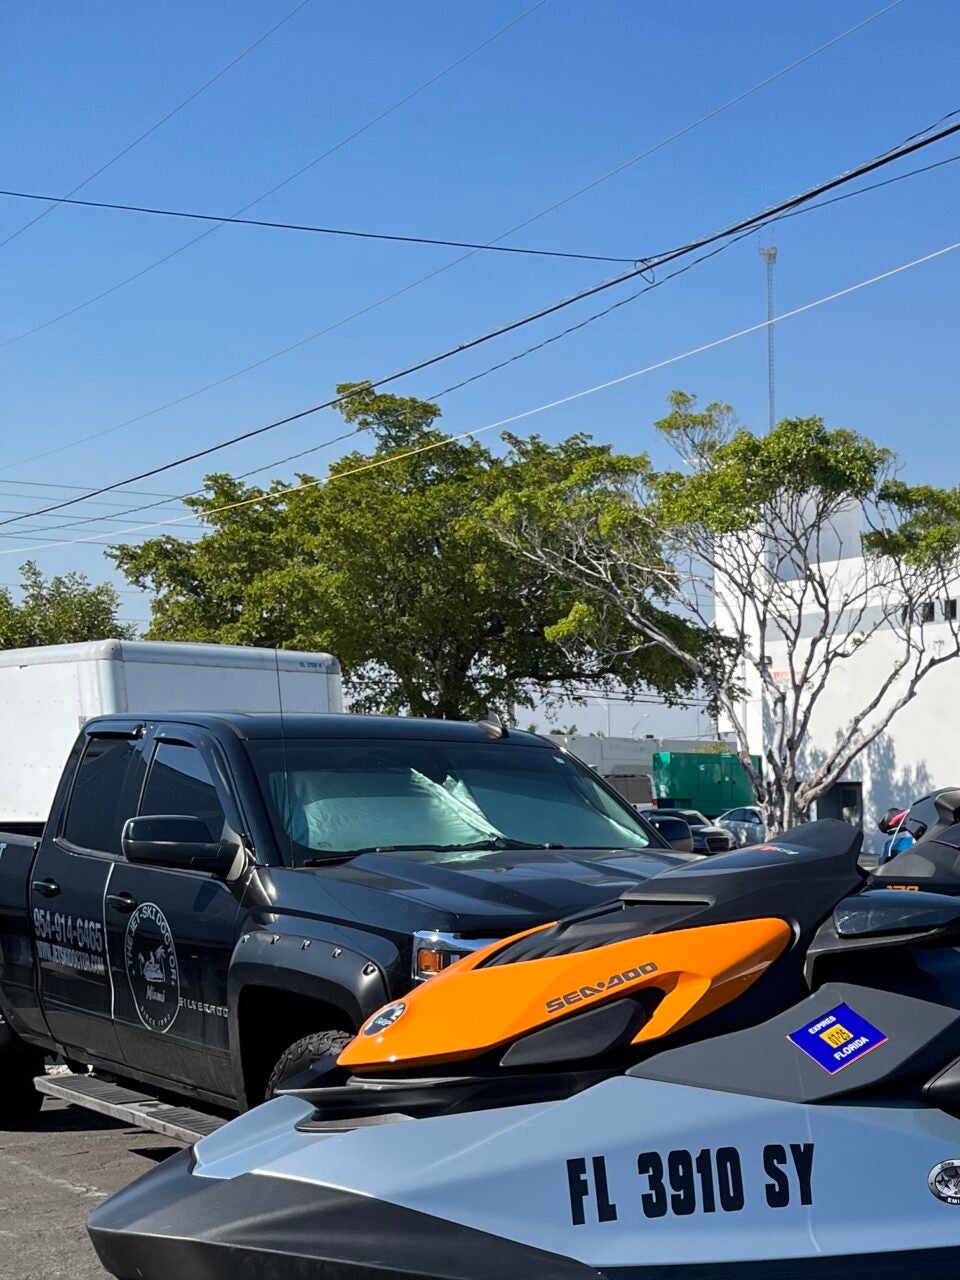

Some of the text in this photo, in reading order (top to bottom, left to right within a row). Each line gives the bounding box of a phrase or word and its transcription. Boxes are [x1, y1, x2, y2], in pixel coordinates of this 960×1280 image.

[33, 908, 102, 952] 954-914-6465
[155, 911, 177, 980] DOCTOR
[808, 1015, 837, 1035] EXPIRES
[833, 1036, 870, 1061] FLORIDA
[566, 1143, 815, 1226] FL 3910 SY
